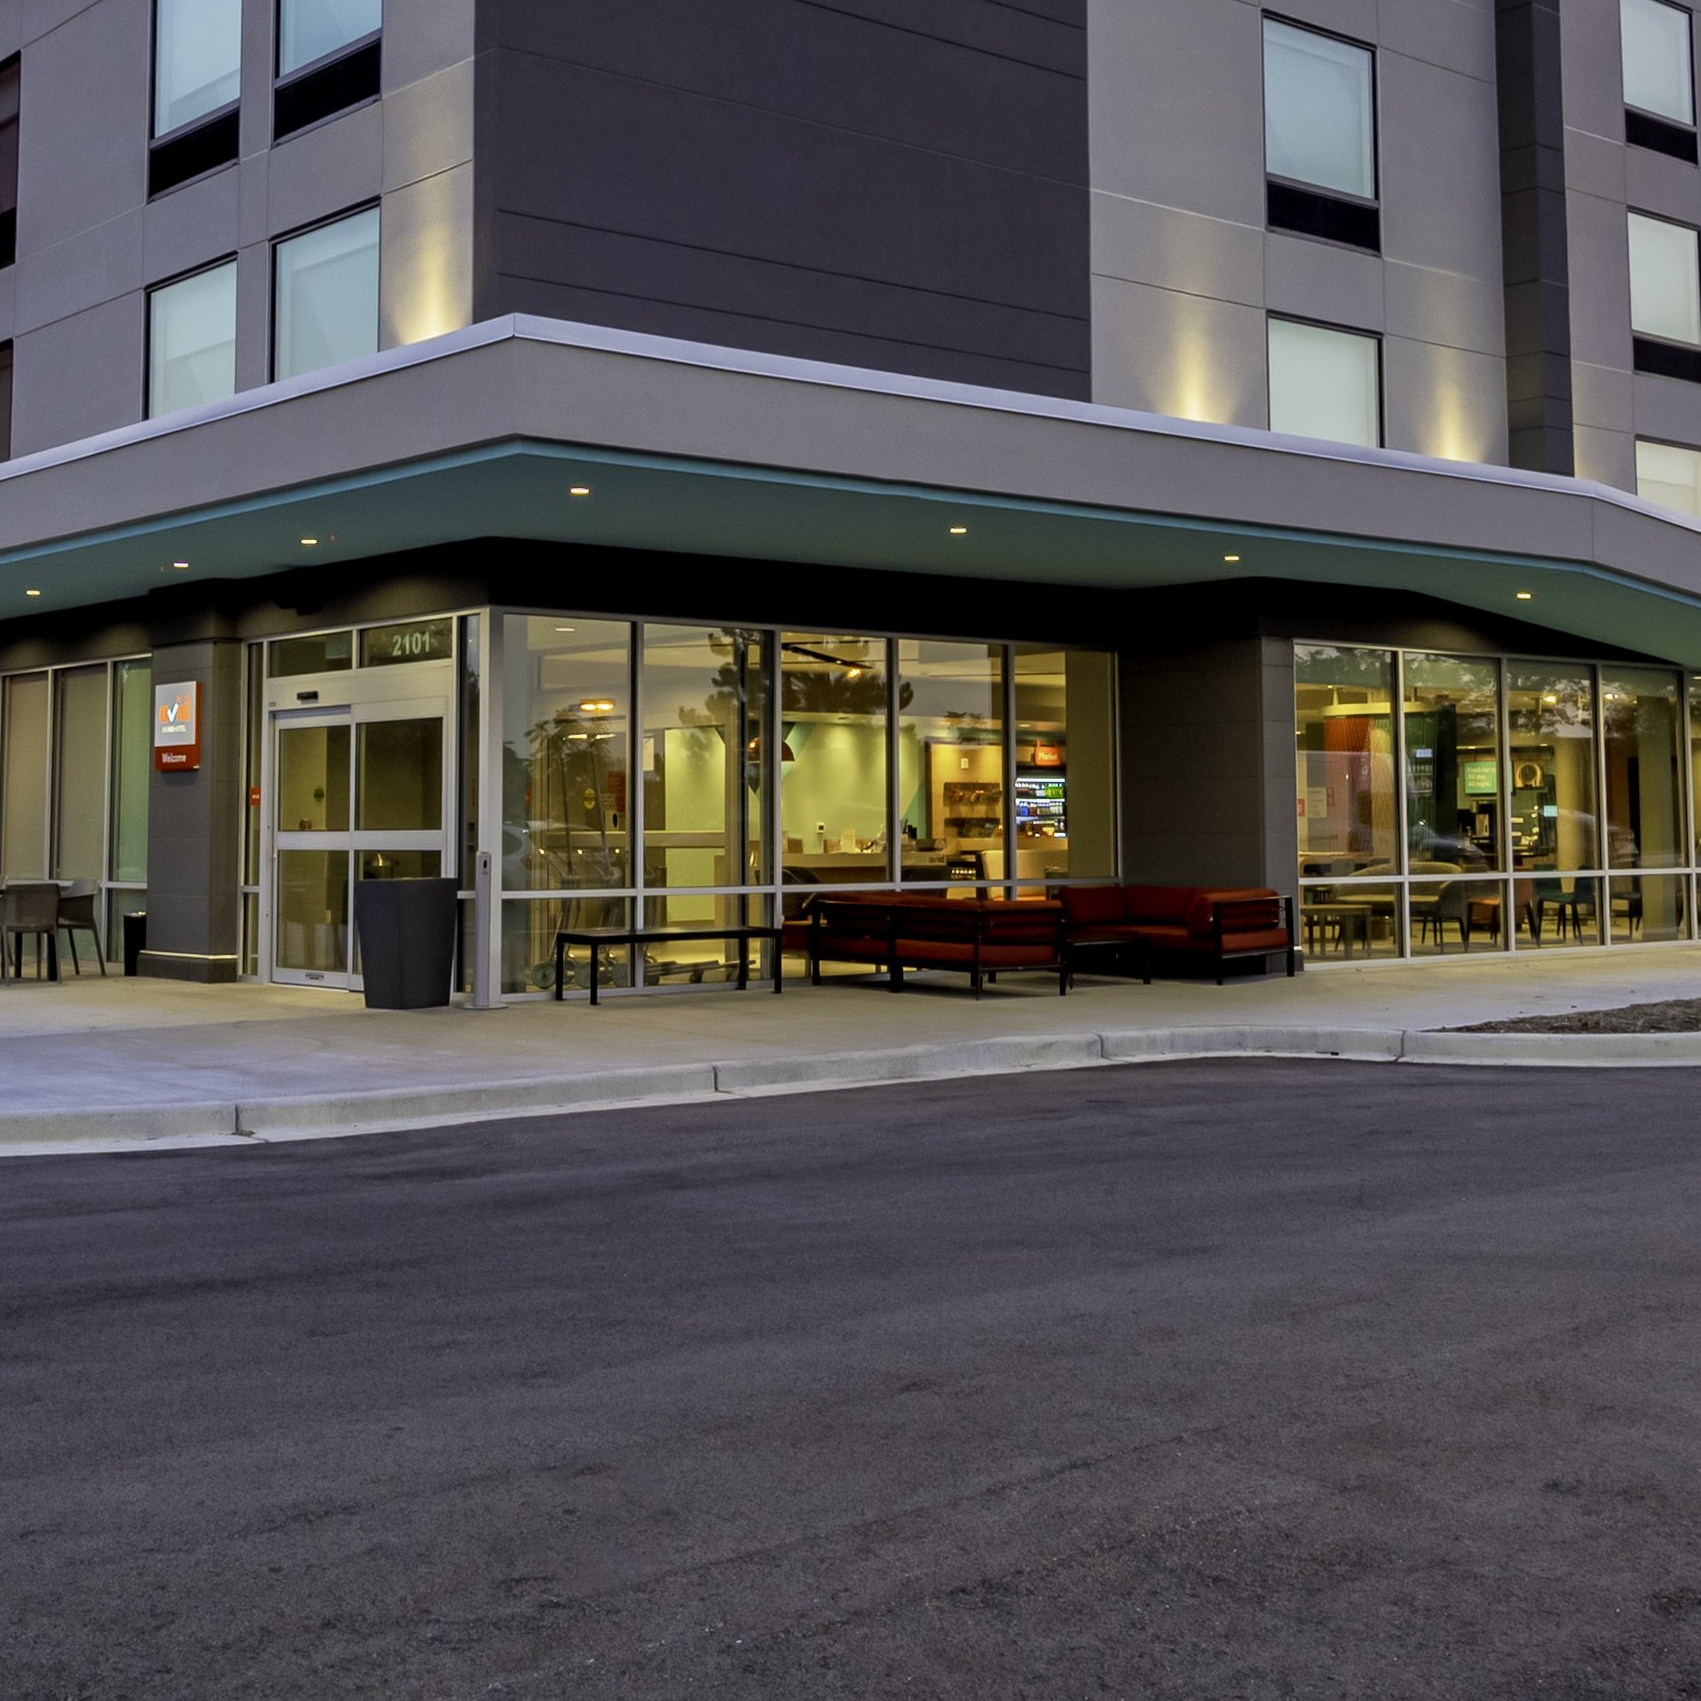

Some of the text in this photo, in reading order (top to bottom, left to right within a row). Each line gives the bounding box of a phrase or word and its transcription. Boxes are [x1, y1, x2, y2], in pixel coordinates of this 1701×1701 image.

[392, 630, 430, 656] 2101
[159, 693, 191, 723] avid
[161, 753, 187, 763] Welcome
